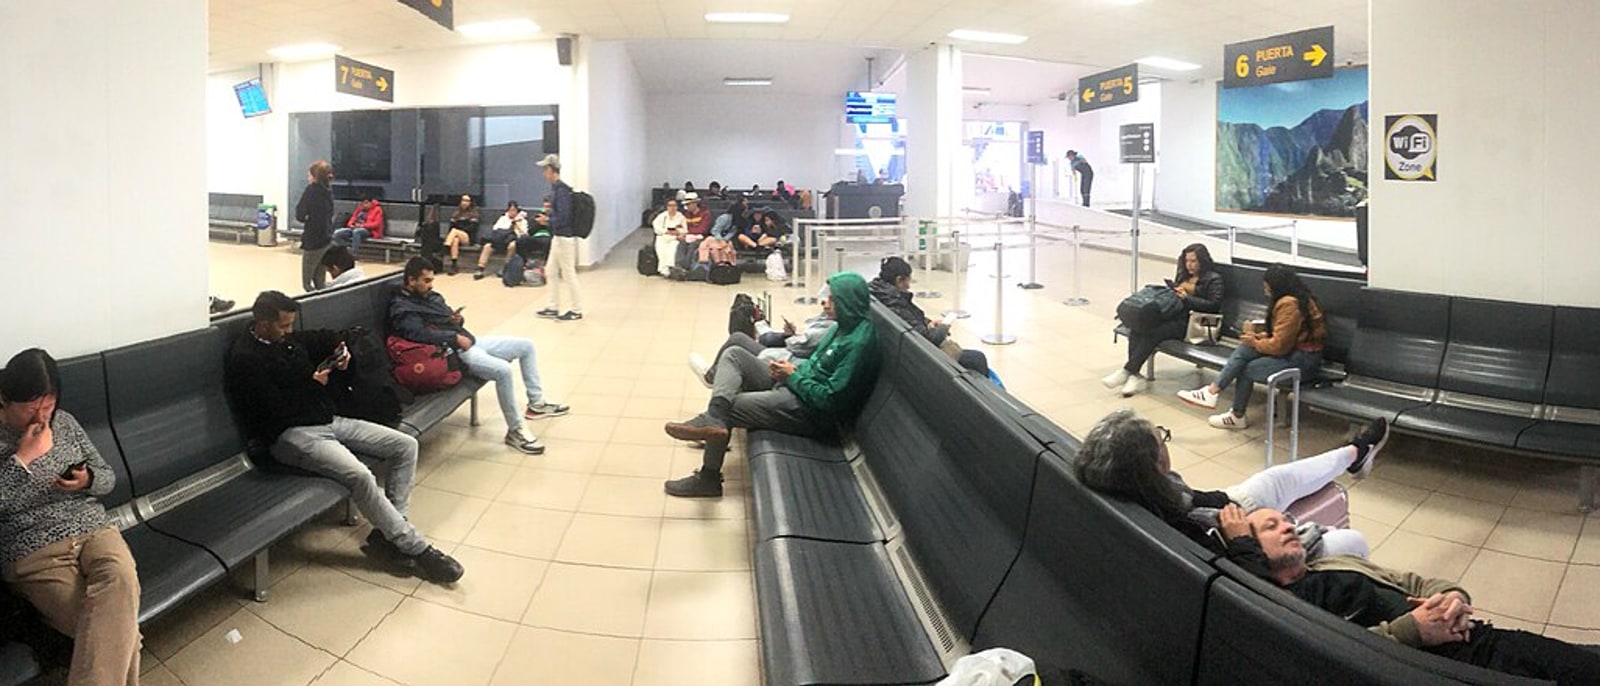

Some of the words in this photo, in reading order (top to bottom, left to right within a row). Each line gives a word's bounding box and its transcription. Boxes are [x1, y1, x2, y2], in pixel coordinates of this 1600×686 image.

[1236, 54, 1249, 77] 6
[1256, 45, 1294, 61] PUERTA
[340, 65, 349, 84] 7
[1256, 66, 1277, 77] Gate
[1123, 76, 1132, 95] 5
[1398, 161, 1422, 172] Zone
